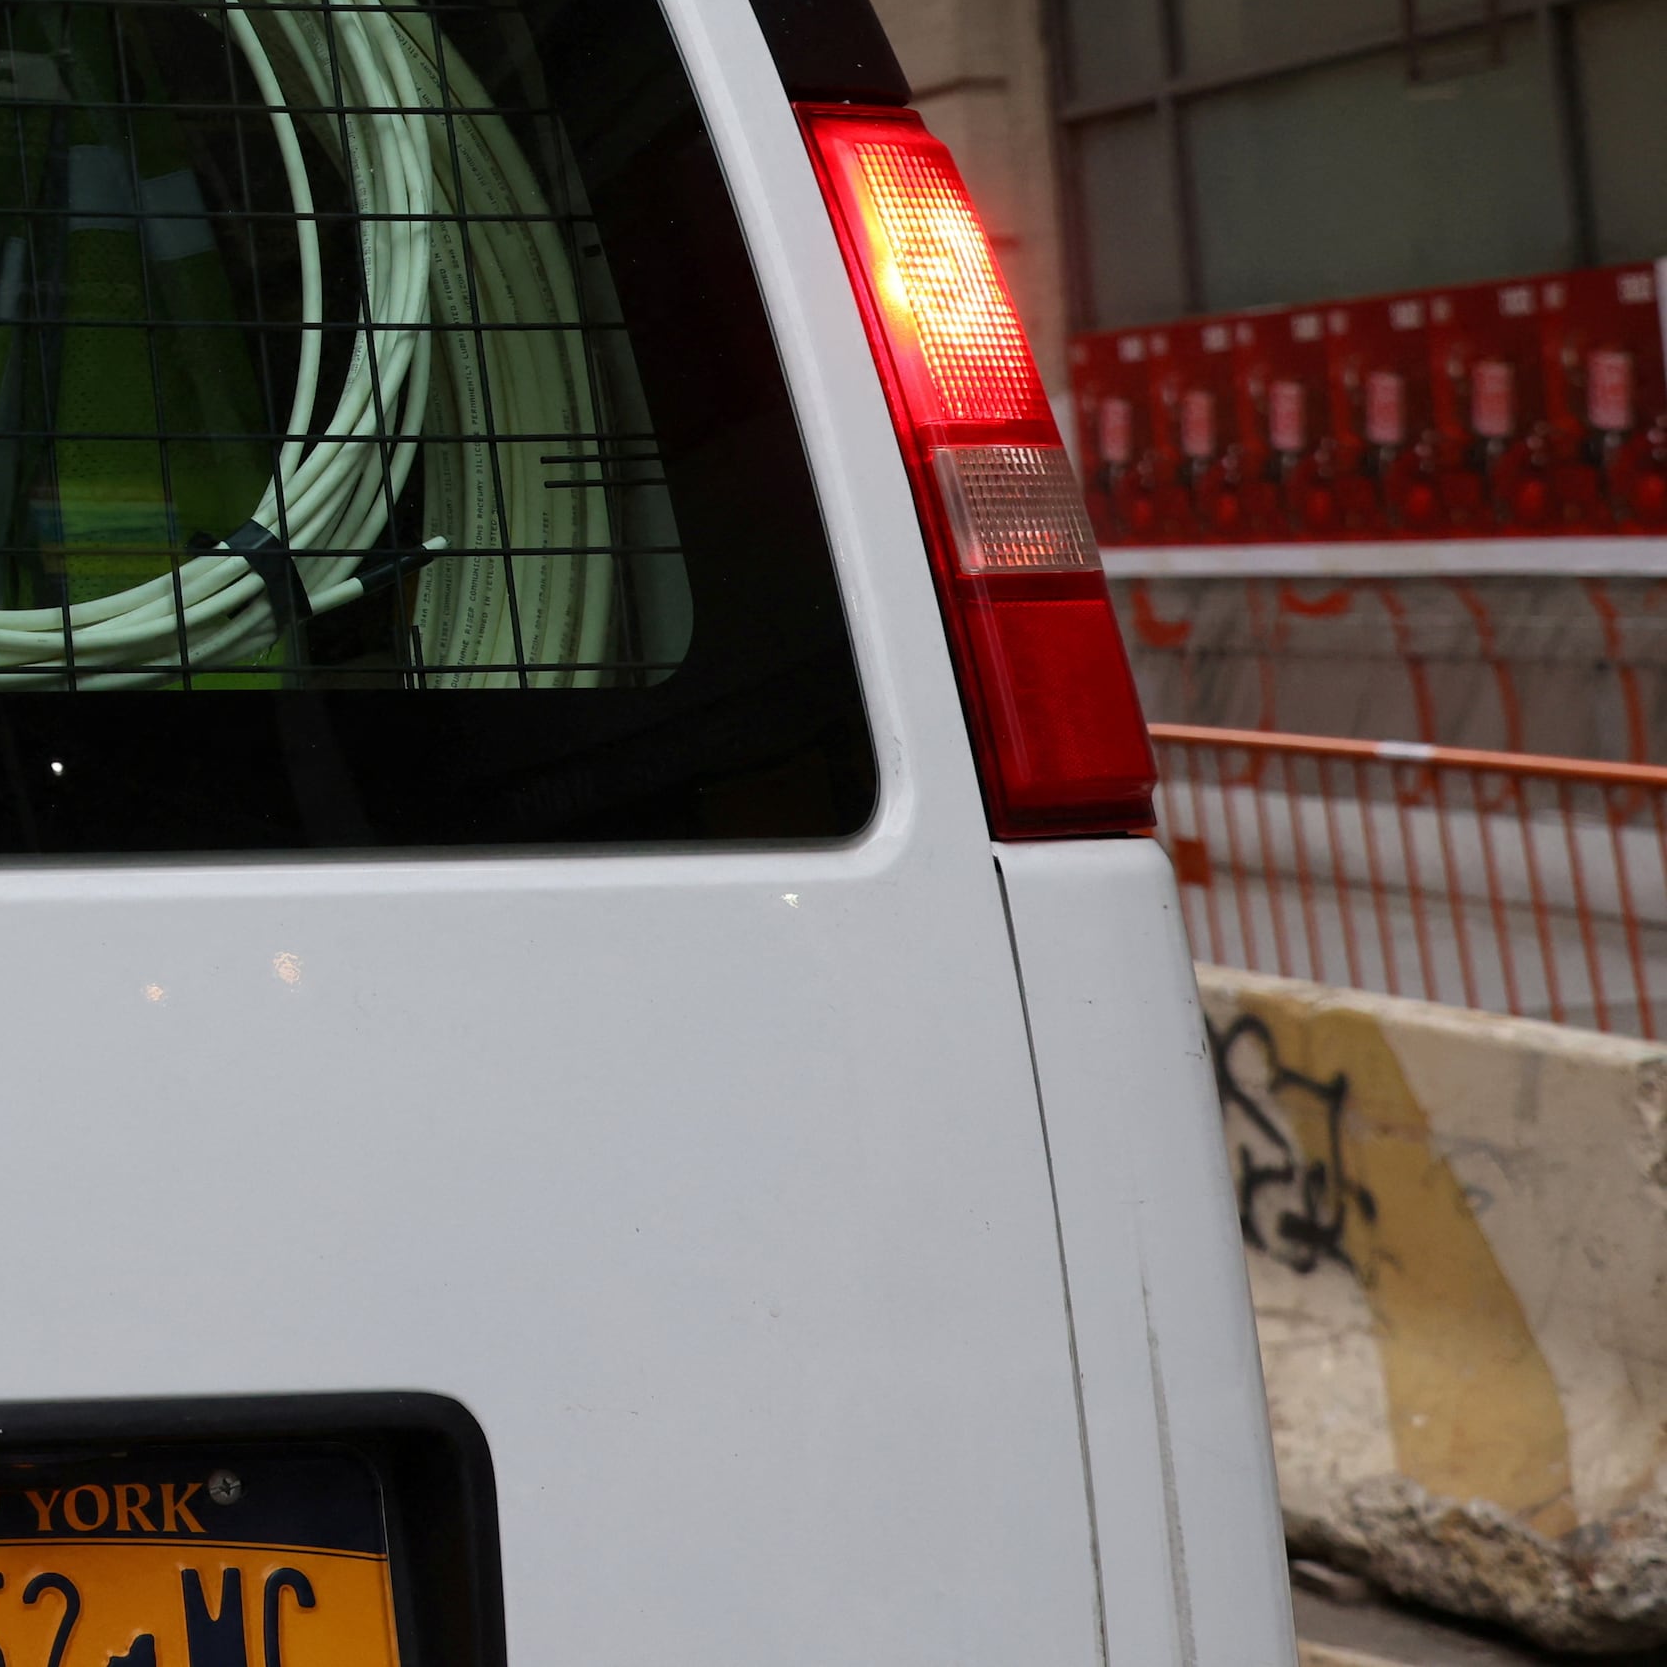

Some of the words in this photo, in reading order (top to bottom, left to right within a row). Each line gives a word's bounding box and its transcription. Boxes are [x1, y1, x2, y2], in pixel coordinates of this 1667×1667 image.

[472, 430, 484, 475] SILICOE
[468, 524, 484, 602] COMMUNICTIONS
[451, 639, 470, 688] DURTHANE
[24, 1483, 208, 1533] YORK
